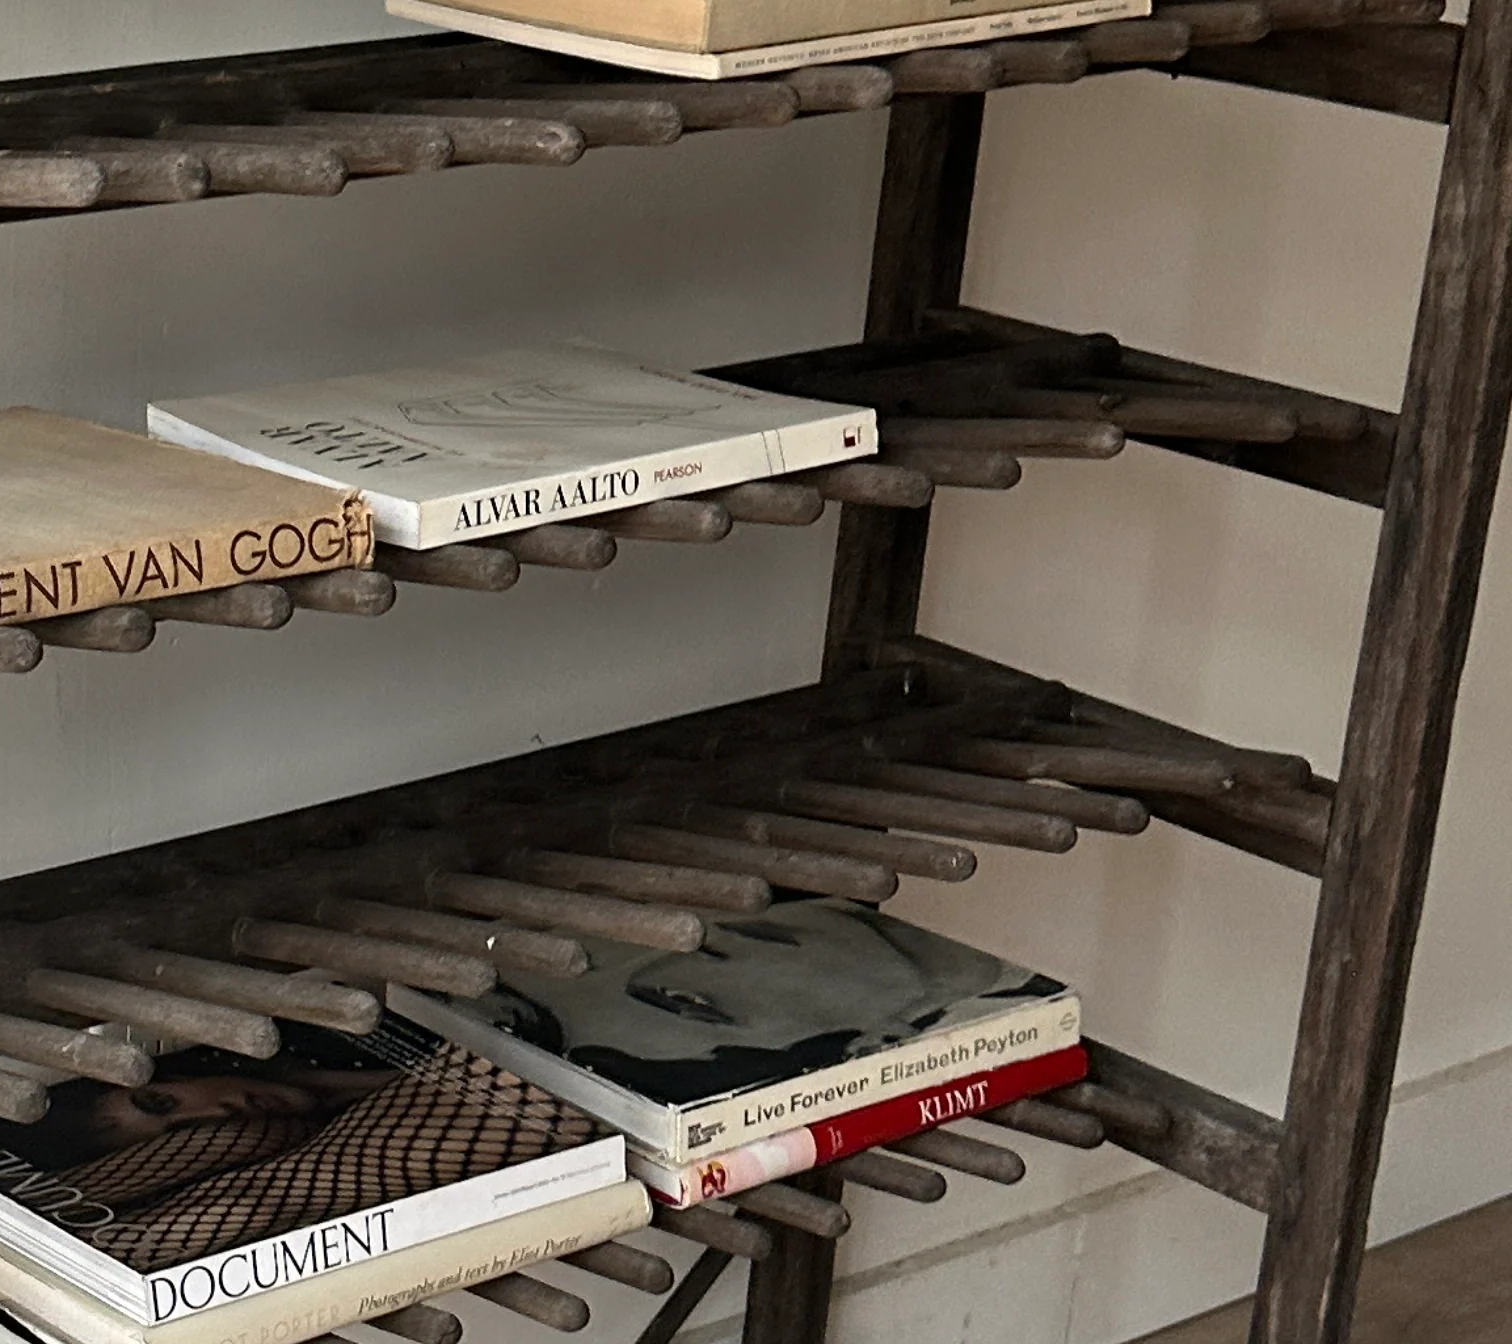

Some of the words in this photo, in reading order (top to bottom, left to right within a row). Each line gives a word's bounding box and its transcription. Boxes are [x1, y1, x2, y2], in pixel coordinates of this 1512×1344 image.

[454, 488, 542, 532] ALVAR
[549, 468, 640, 513] AALTO
[653, 461, 704, 484] PEARSON
[102, 538, 205, 597] VAN
[230, 513, 373, 576] GOGH
[881, 1044, 970, 1085] Elizabeth
[974, 1026, 1039, 1059] Peyton
[743, 1102, 785, 1127] Live
[790, 1075, 869, 1113] Forever
[917, 1081, 989, 1126] KLIMT
[150, 1208, 394, 1322] DOCUMENT
[357, 1276, 435, 1317] Photographs
[438, 1266, 462, 1289] and
[464, 1261, 489, 1283] text
[490, 1255, 508, 1275] by
[543, 1234, 582, 1258] Porter
